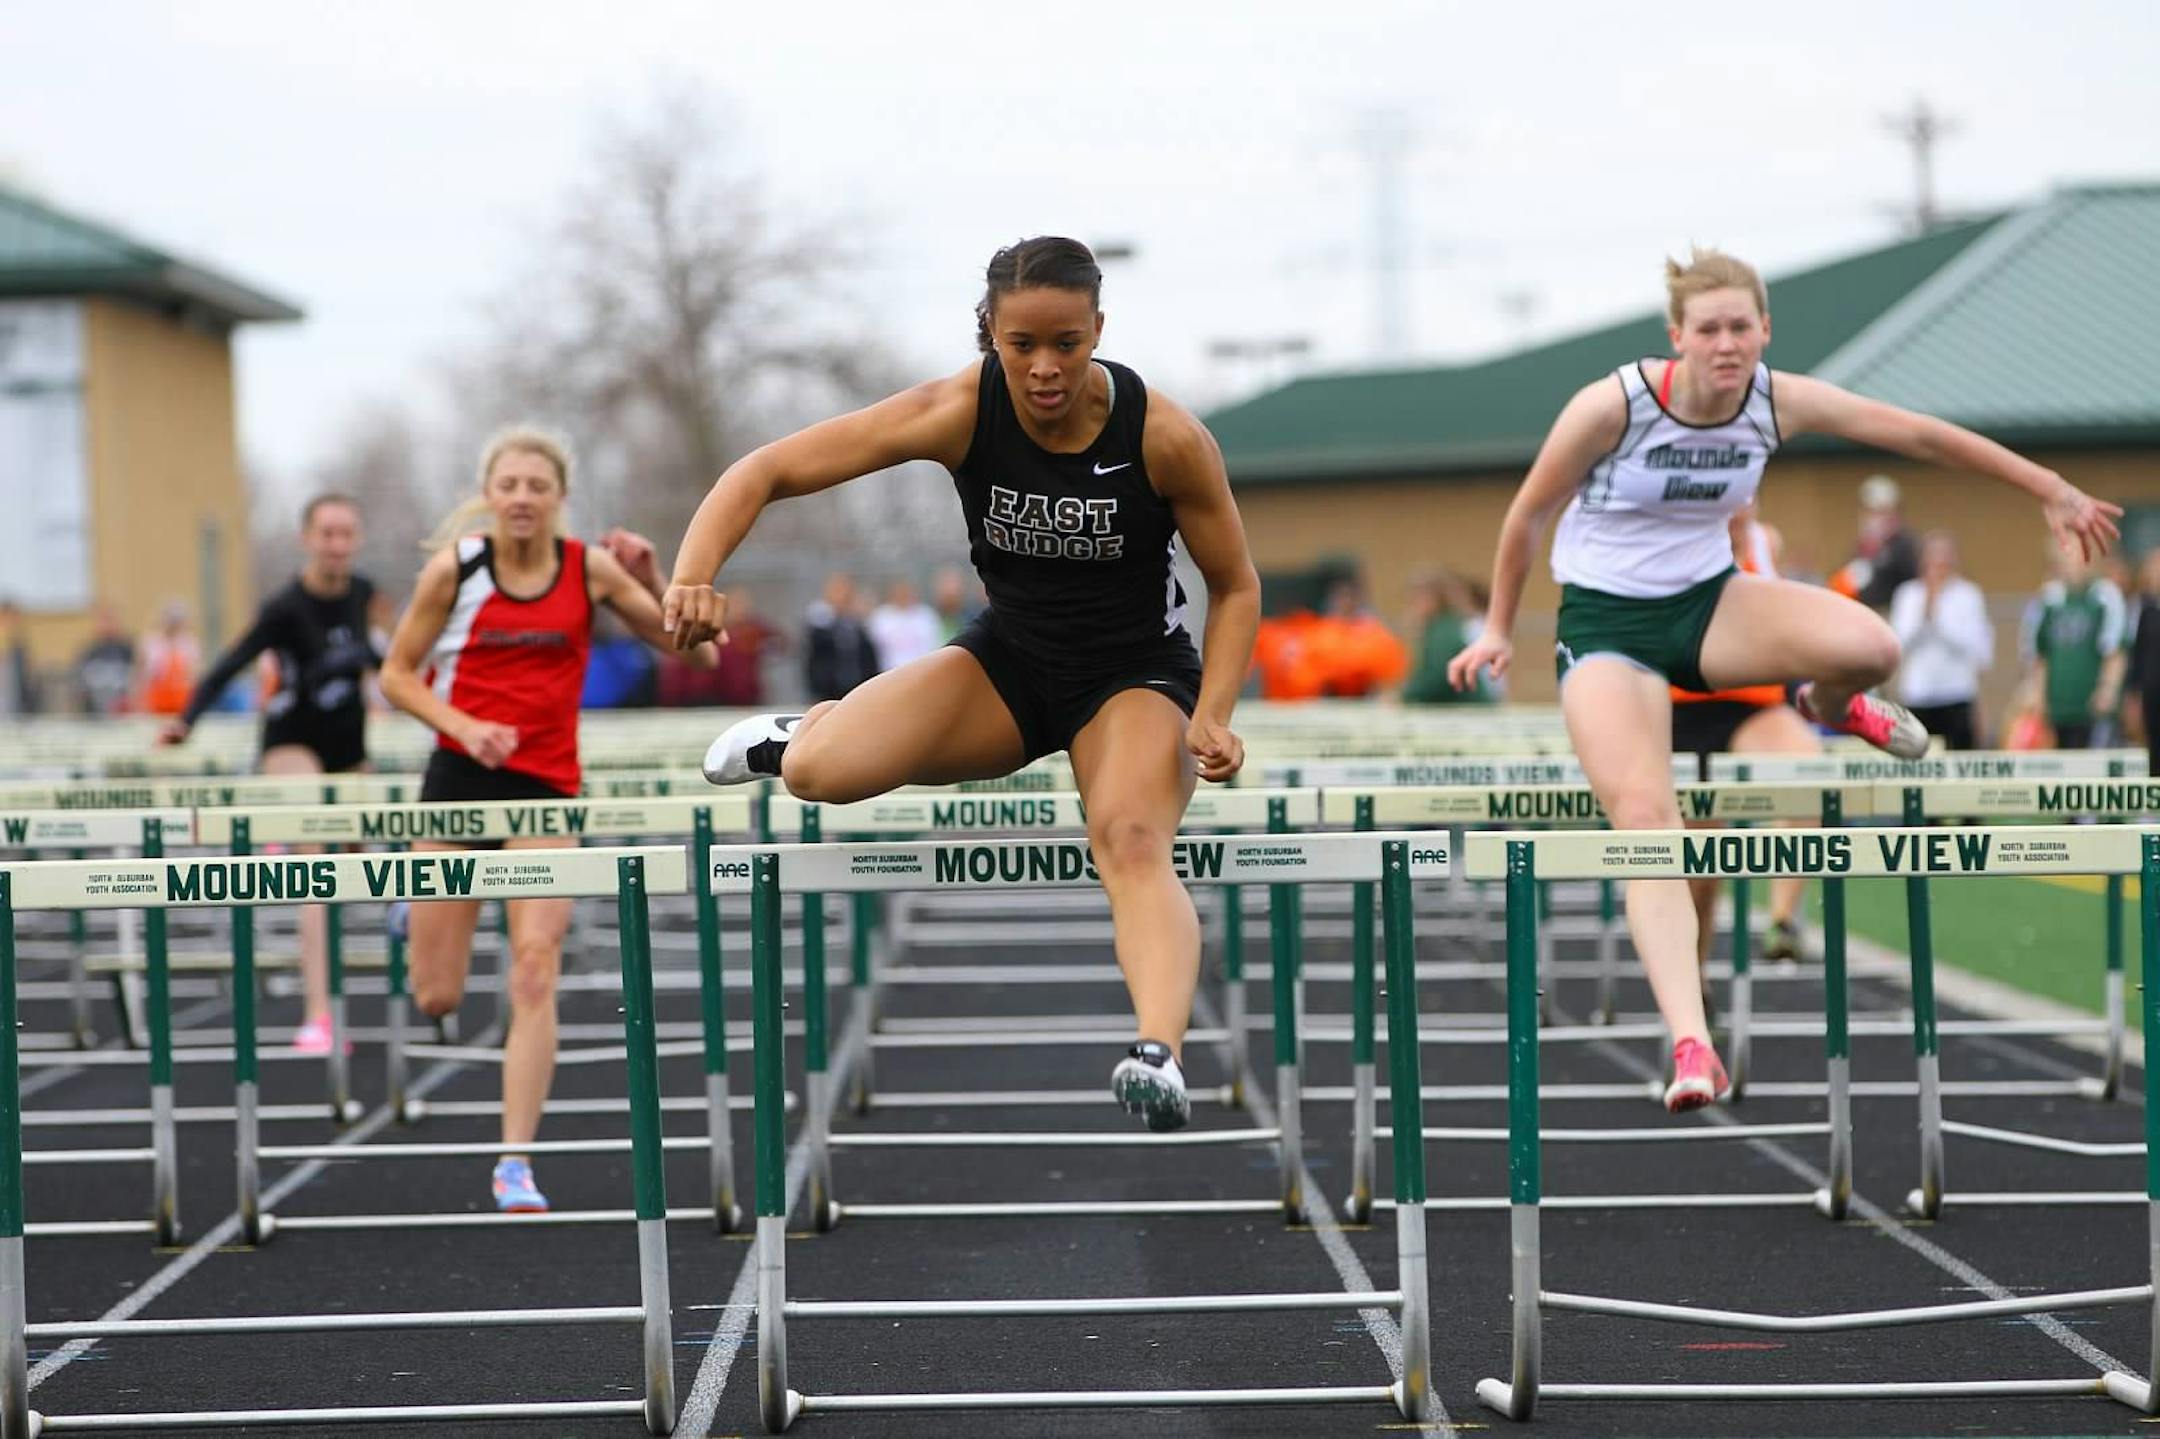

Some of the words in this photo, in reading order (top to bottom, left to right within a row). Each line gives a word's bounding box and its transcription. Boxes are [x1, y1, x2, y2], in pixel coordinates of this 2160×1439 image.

[988, 485, 1118, 534] EAST
[983, 517, 1124, 561] RIDGE
[1844, 759, 1946, 780] MOUNDS
[1955, 758, 2017, 778] VIEW
[932, 799, 1056, 828] MOUNDS
[2038, 784, 2160, 811] MOUNDS
[360, 808, 486, 837] MOUNDS
[503, 806, 589, 835] VIEW
[850, 865, 875, 874] YOUTH
[1172, 842, 1225, 879] EW
[1683, 835, 1852, 874] MOUNDS
[1878, 834, 1992, 872] VIEW
[166, 861, 337, 901] MOUNDS
[362, 858, 476, 897] VIEW
